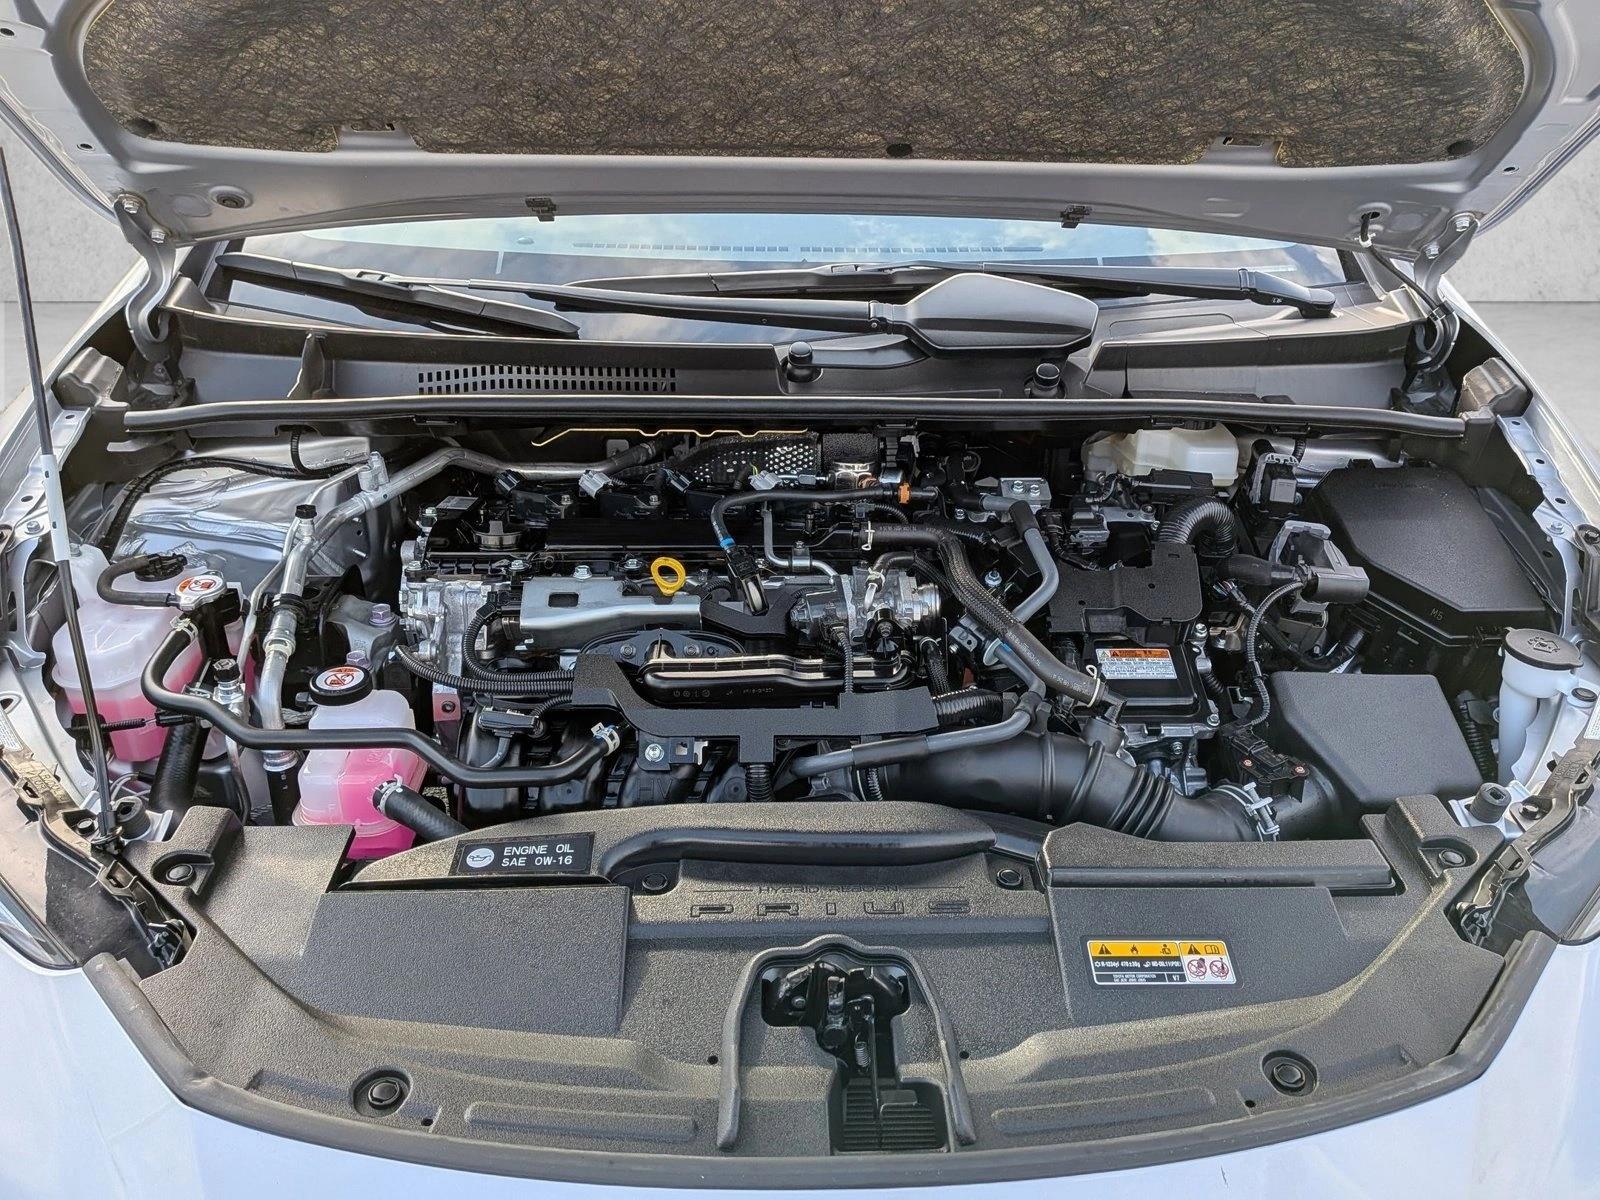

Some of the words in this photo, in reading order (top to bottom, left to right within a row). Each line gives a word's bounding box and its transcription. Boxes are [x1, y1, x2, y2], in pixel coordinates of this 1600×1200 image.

[503, 845, 548, 856] ENGINE
[555, 843, 574, 853] OIL
[501, 857, 527, 867] SAE
[534, 855, 573, 866] 0W-16
[758, 885, 820, 895] HYBRID
[827, 884, 899, 894] REBORN
[690, 901, 971, 918] PRIUS
